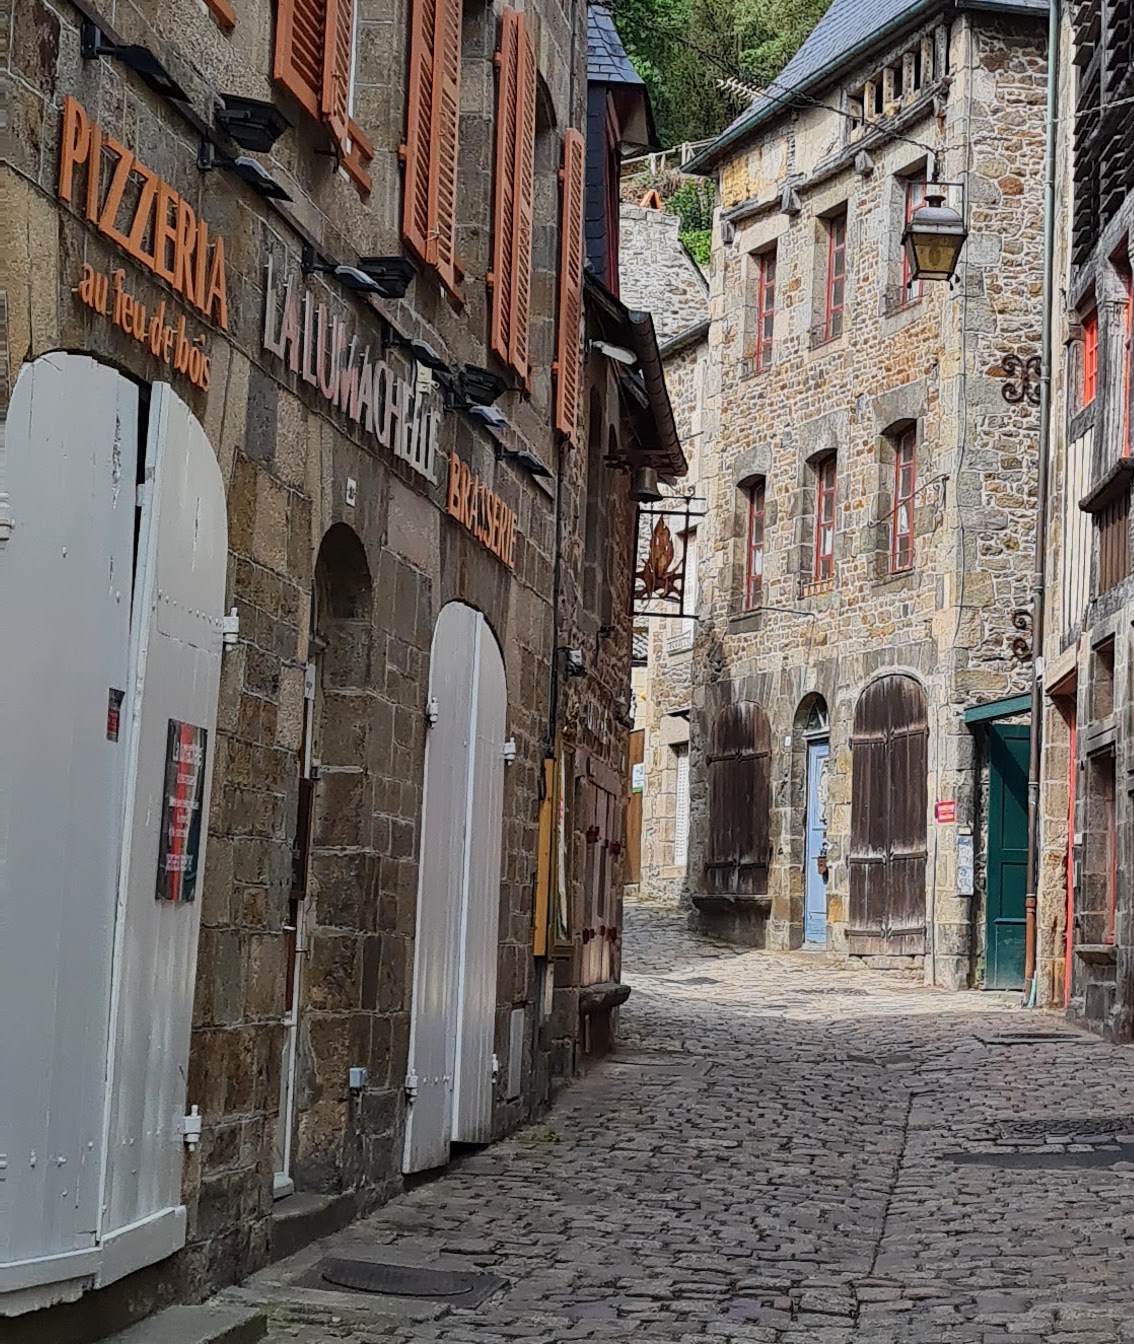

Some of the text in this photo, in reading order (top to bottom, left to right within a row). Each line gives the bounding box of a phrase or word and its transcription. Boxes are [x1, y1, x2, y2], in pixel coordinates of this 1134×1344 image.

[58, 95, 229, 332] PIZZERIA
[78, 262, 212, 392] au feu de bois
[263, 254, 300, 375] LA
[447, 452, 518, 570] BRASSERIE
